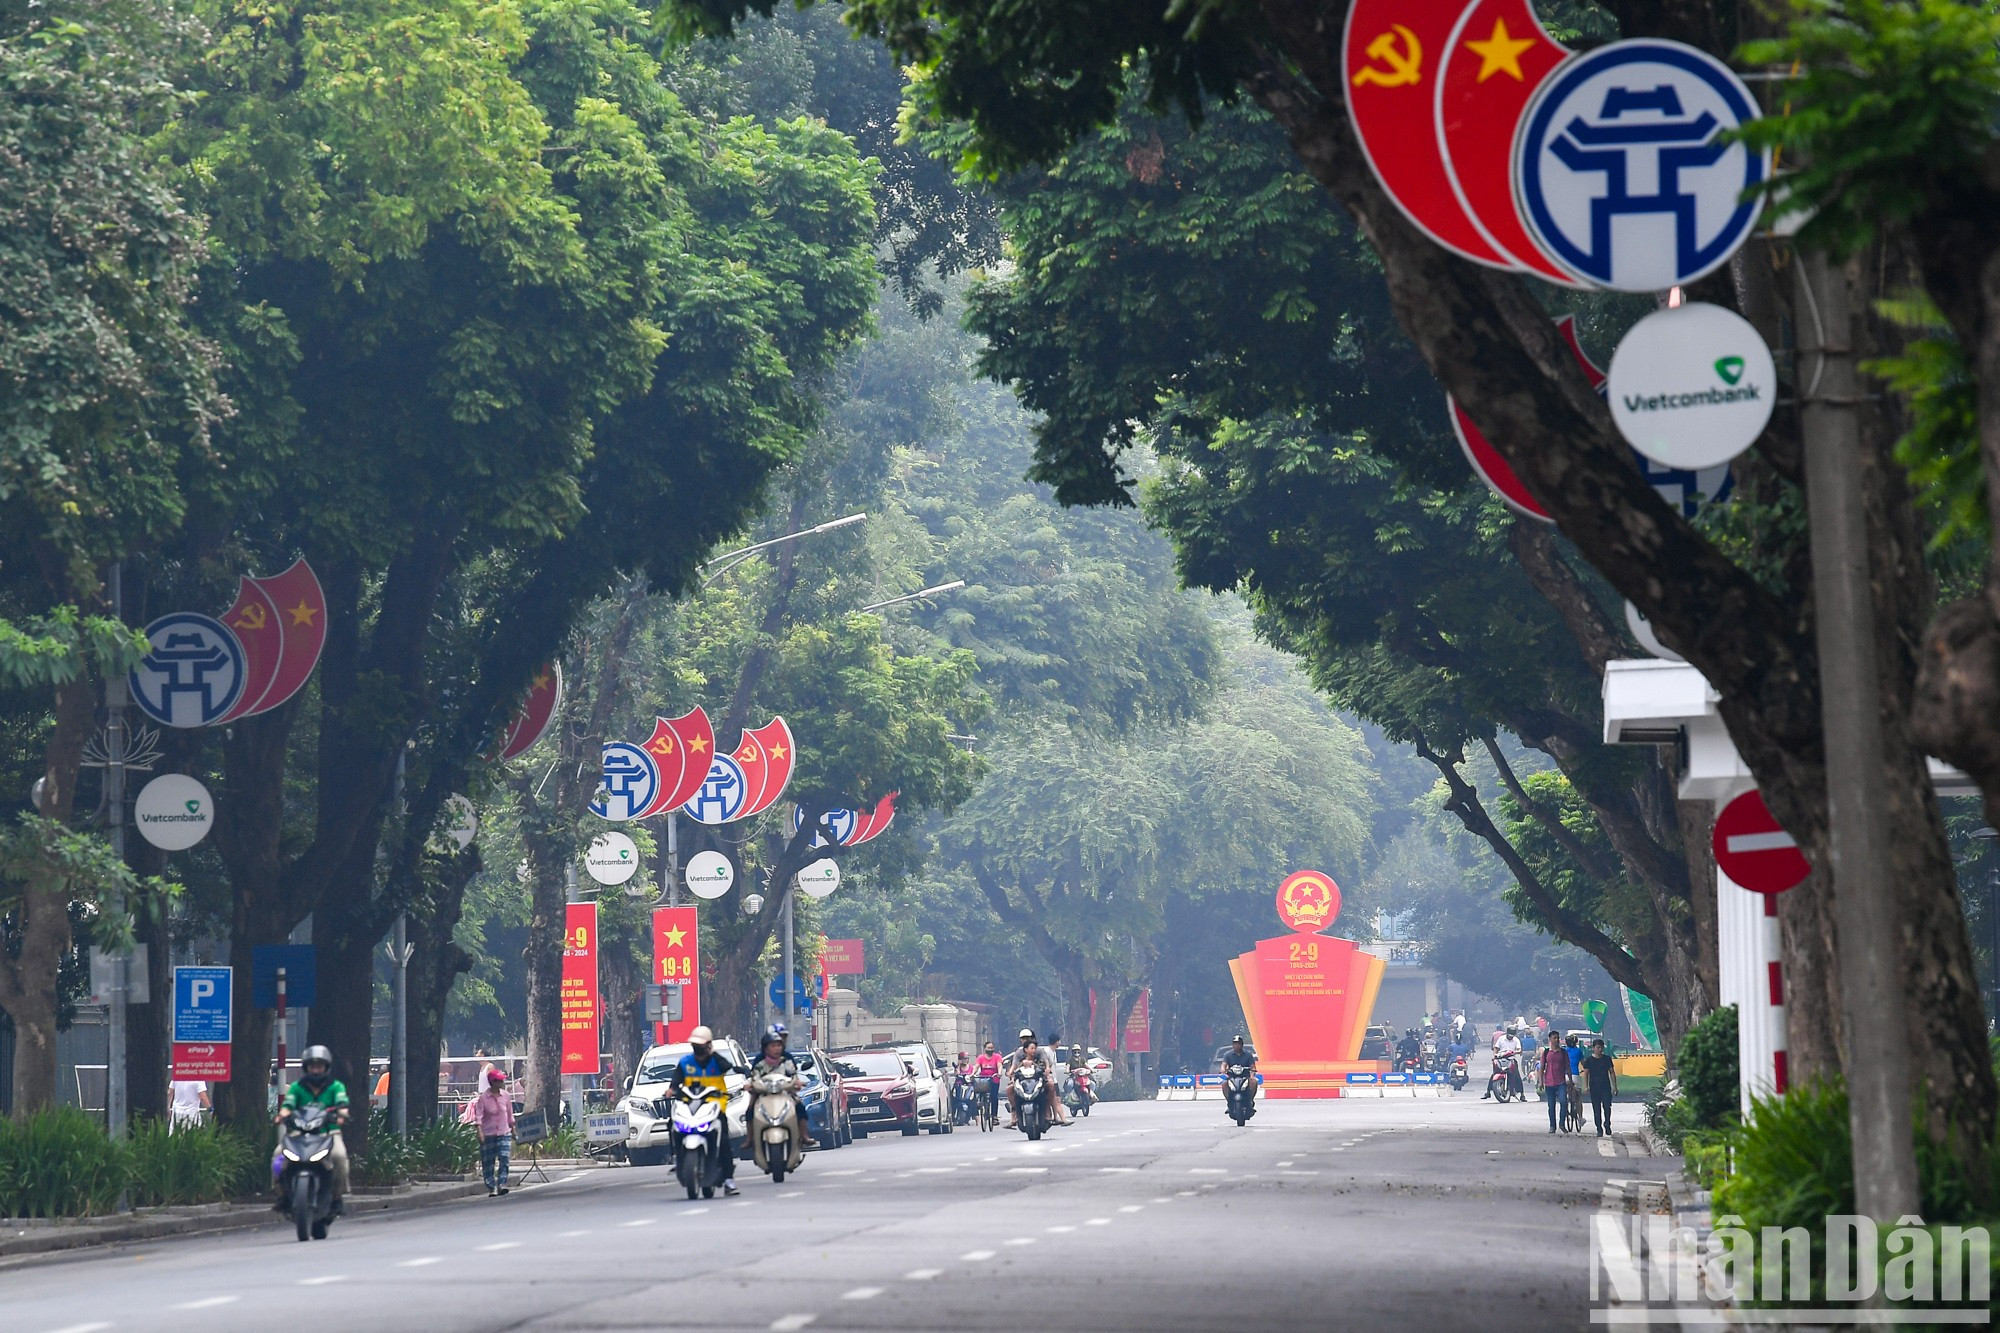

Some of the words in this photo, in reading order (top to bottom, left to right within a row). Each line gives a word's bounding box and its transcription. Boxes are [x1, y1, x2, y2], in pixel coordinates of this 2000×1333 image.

[1624, 383, 1761, 413] Vietcombank
[142, 813, 206, 823] Vietcombank
[590, 857, 634, 866] Vietcombank
[690, 874, 729, 882] Vietcombank
[801, 875, 836, 883] Vietcombank
[1290, 942, 1318, 961] 2-9
[191, 980, 215, 1008] P
